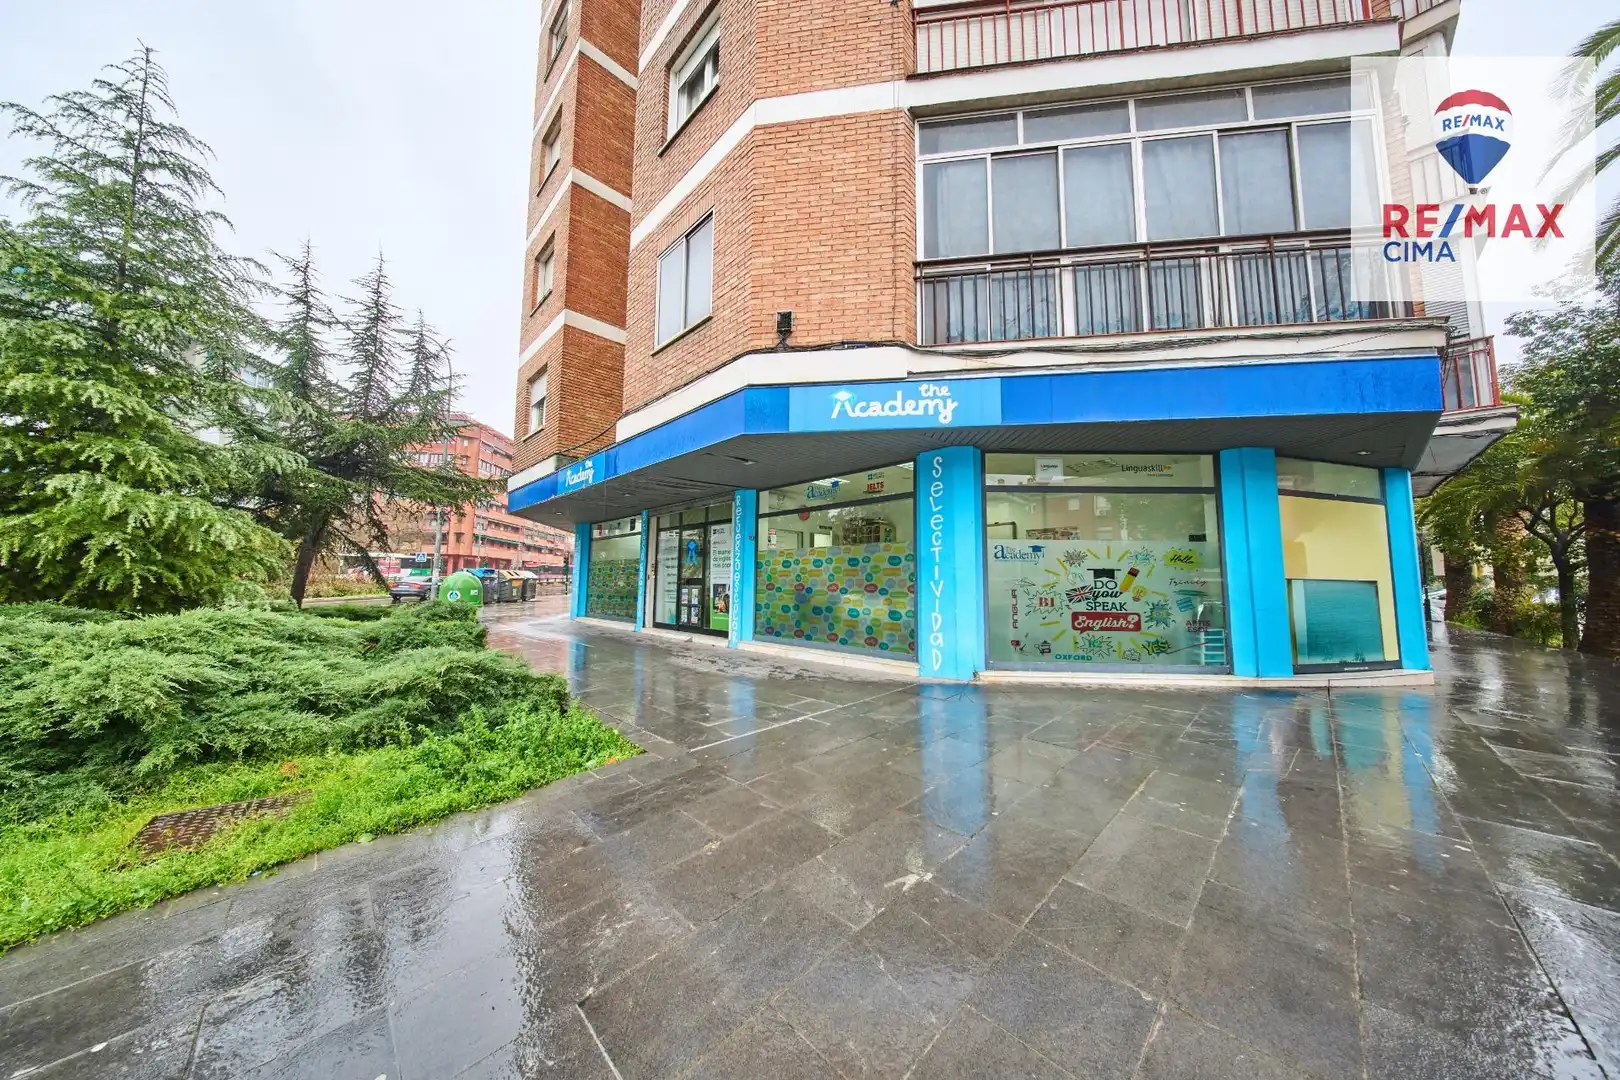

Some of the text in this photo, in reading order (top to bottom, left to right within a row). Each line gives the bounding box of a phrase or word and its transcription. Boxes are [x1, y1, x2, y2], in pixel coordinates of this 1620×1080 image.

[919, 383, 951, 397] the
[830, 390, 959, 424] Academy
[1121, 463, 1164, 474] Linguaskill
[867, 481, 884, 491] IELTS
[993, 544, 1040, 565] academy
[1170, 553, 1195, 564] Hello
[1094, 580, 1118, 590] DO
[1169, 578, 1207, 586] Trinity
[1091, 590, 1123, 601] you
[1011, 589, 1019, 629] ANGLIA
[1085, 601, 1128, 612] SPEAK
[1074, 614, 1140, 630] English?
